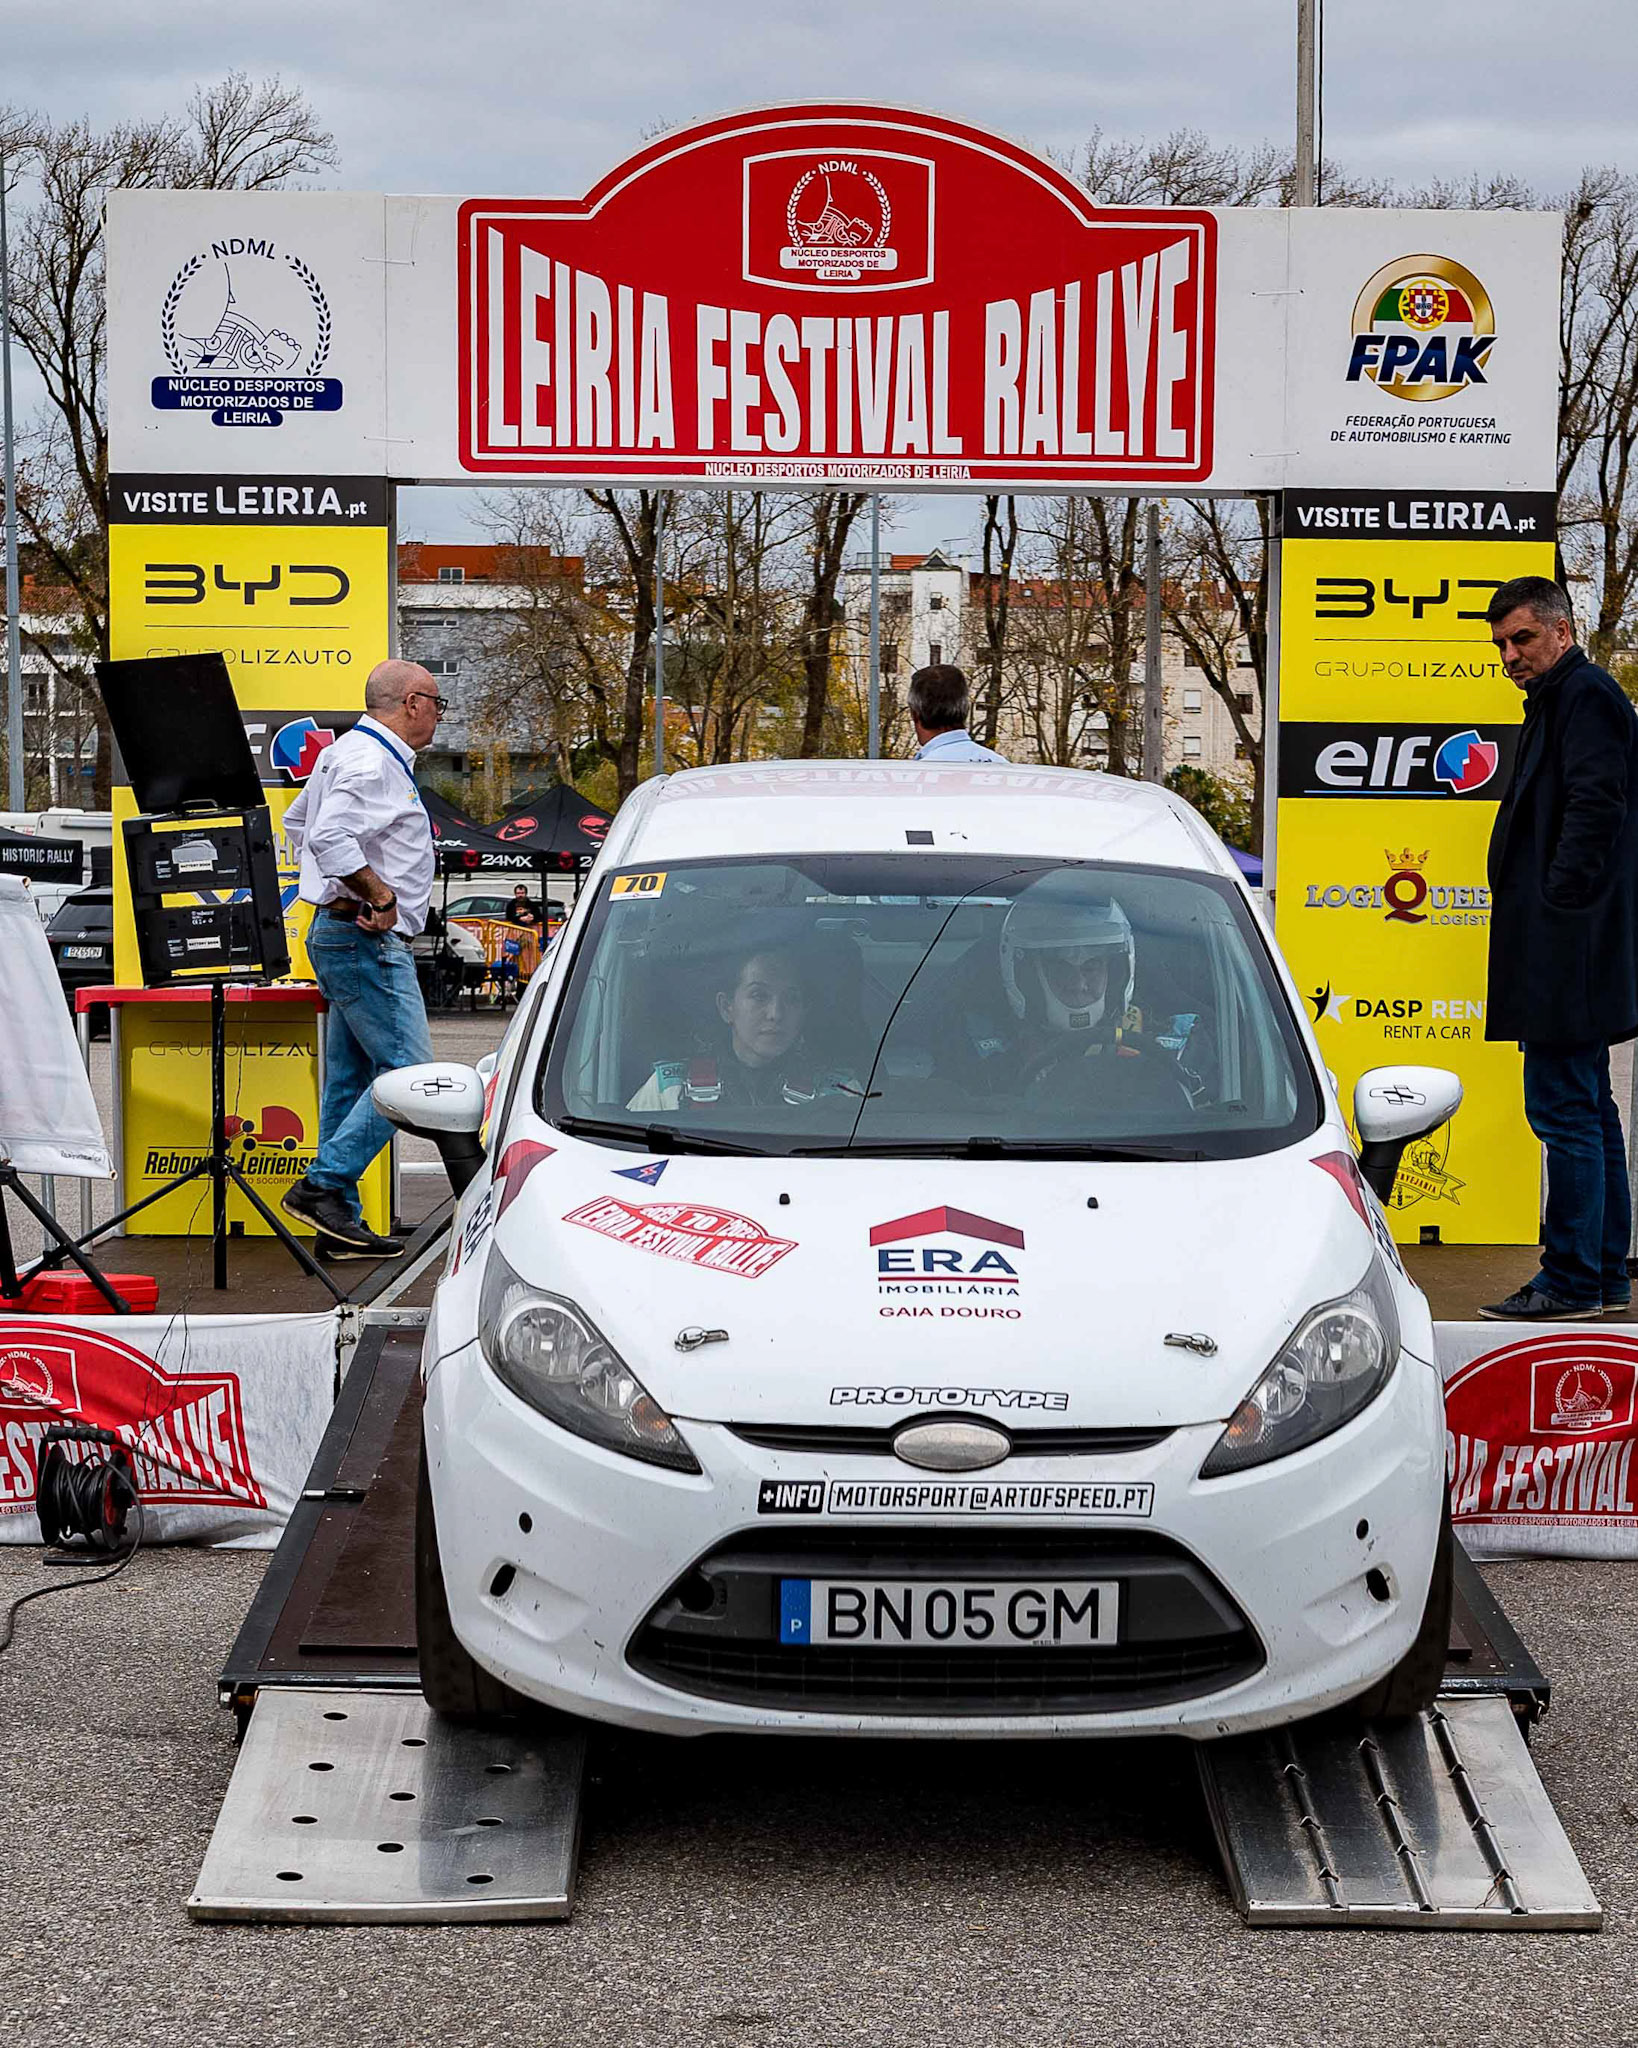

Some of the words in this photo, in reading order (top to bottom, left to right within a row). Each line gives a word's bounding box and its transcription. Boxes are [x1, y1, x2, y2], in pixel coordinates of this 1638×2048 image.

[818, 160, 858, 175] NDML
[211, 237, 275, 260] NDML
[830, 250, 886, 258] DESPORTOS
[798, 260, 864, 268] MOTORIZADOS
[867, 260, 879, 268] DE
[487, 225, 676, 450] LEIRIA
[696, 303, 963, 456] FESTIVAL
[985, 236, 1191, 458] RALLYE
[1346, 334, 1498, 384] FPAK
[168, 377, 230, 391] NÚCLEO
[234, 380, 325, 392] DESPORTOS
[180, 395, 289, 408] MOTORIZADOS
[293, 397, 314, 408] DE
[223, 412, 272, 424] LEIRIA
[1345, 413, 1415, 429] FEDERAÇÃO
[1418, 417, 1496, 428] PORTUGUESA
[1331, 431, 1346, 441] DE
[1349, 431, 1446, 443] AUTOMOBILISMO
[1450, 433, 1457, 443] E
[1459, 433, 1512, 444] KARTING
[755, 463, 825, 477] DESPORTOS
[828, 465, 912, 478] MOTORIZADOS
[914, 466, 930, 479] DE
[932, 466, 971, 479] LEIRIA
[123, 491, 208, 514] VISITE
[1297, 505, 1380, 529] VISITE
[145, 564, 350, 605] BYD
[1314, 736, 1431, 787] elf
[2, 848, 46, 863] HISTORIC
[47, 849, 74, 863] RALLY
[481, 854, 533, 868] 24MX
[624, 875, 659, 892] 70
[1355, 999, 1423, 1018] DASP
[1431, 1000, 1487, 1019] REN
[1384, 1026, 1420, 1039] RENT
[1426, 1026, 1437, 1039] A
[1441, 1026, 1471, 1039] CAR
[682, 1212, 719, 1231] 70
[573, 1200, 644, 1237] LEIRIA
[622, 1222, 714, 1263] FESTIVAL
[877, 1248, 1019, 1275] ERA
[878, 1283, 1020, 1297] IMOBILIÁRIA
[879, 1306, 934, 1319] GAIA
[940, 1307, 1022, 1320] DOURO
[829, 1386, 1070, 1411] PROTOTYPE
[1490, 1438, 1637, 1512] FESTIVAL
[761, 1483, 821, 1508] +INFO
[834, 1485, 1149, 1511] MOTORSPORT@ARTOFSPEED.PT
[1519, 1517, 1558, 1526] DESPORTOS
[1559, 1518, 1605, 1526] MOTORIZADOS
[1616, 1519, 1638, 1528] LEIRIA
[790, 1620, 802, 1633] P
